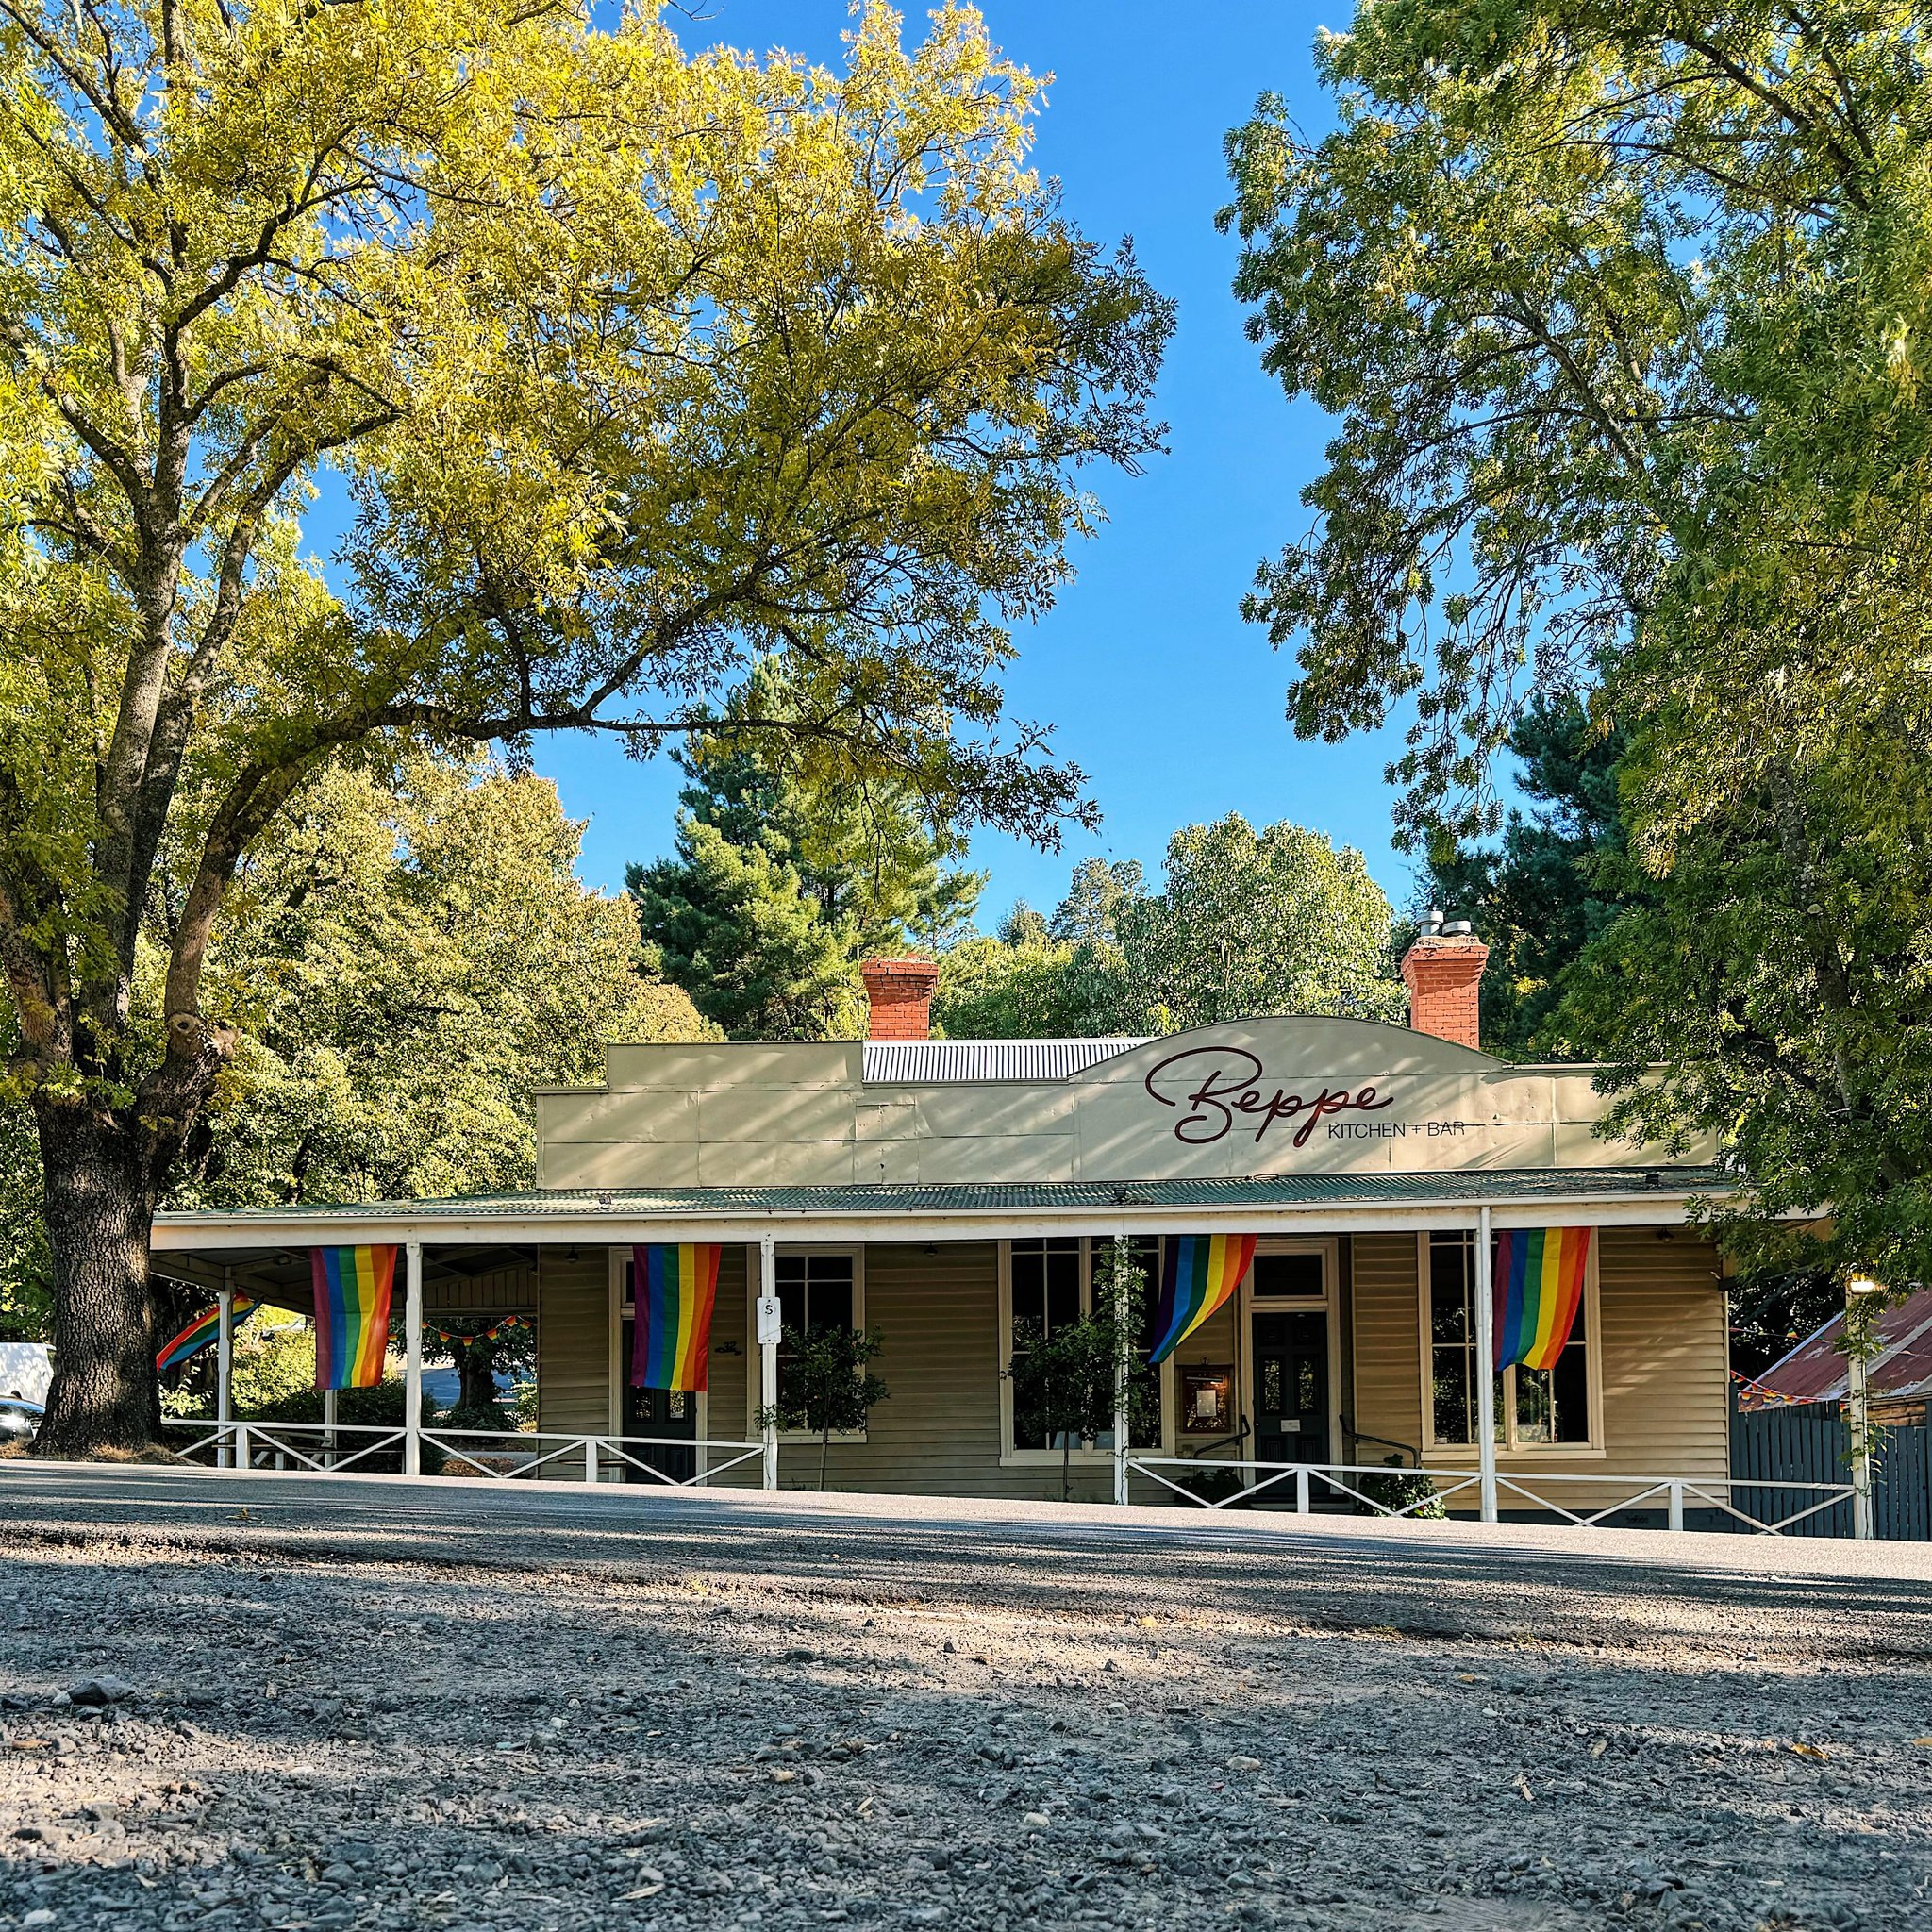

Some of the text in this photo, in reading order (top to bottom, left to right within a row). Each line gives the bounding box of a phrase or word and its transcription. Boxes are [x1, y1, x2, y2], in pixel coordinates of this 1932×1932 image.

[1145, 1046, 1394, 1148] Beppe
[1328, 1123, 1406, 1139] KITCHEN
[1427, 1121, 1465, 1137] BAR
[765, 1305, 773, 1315] S
